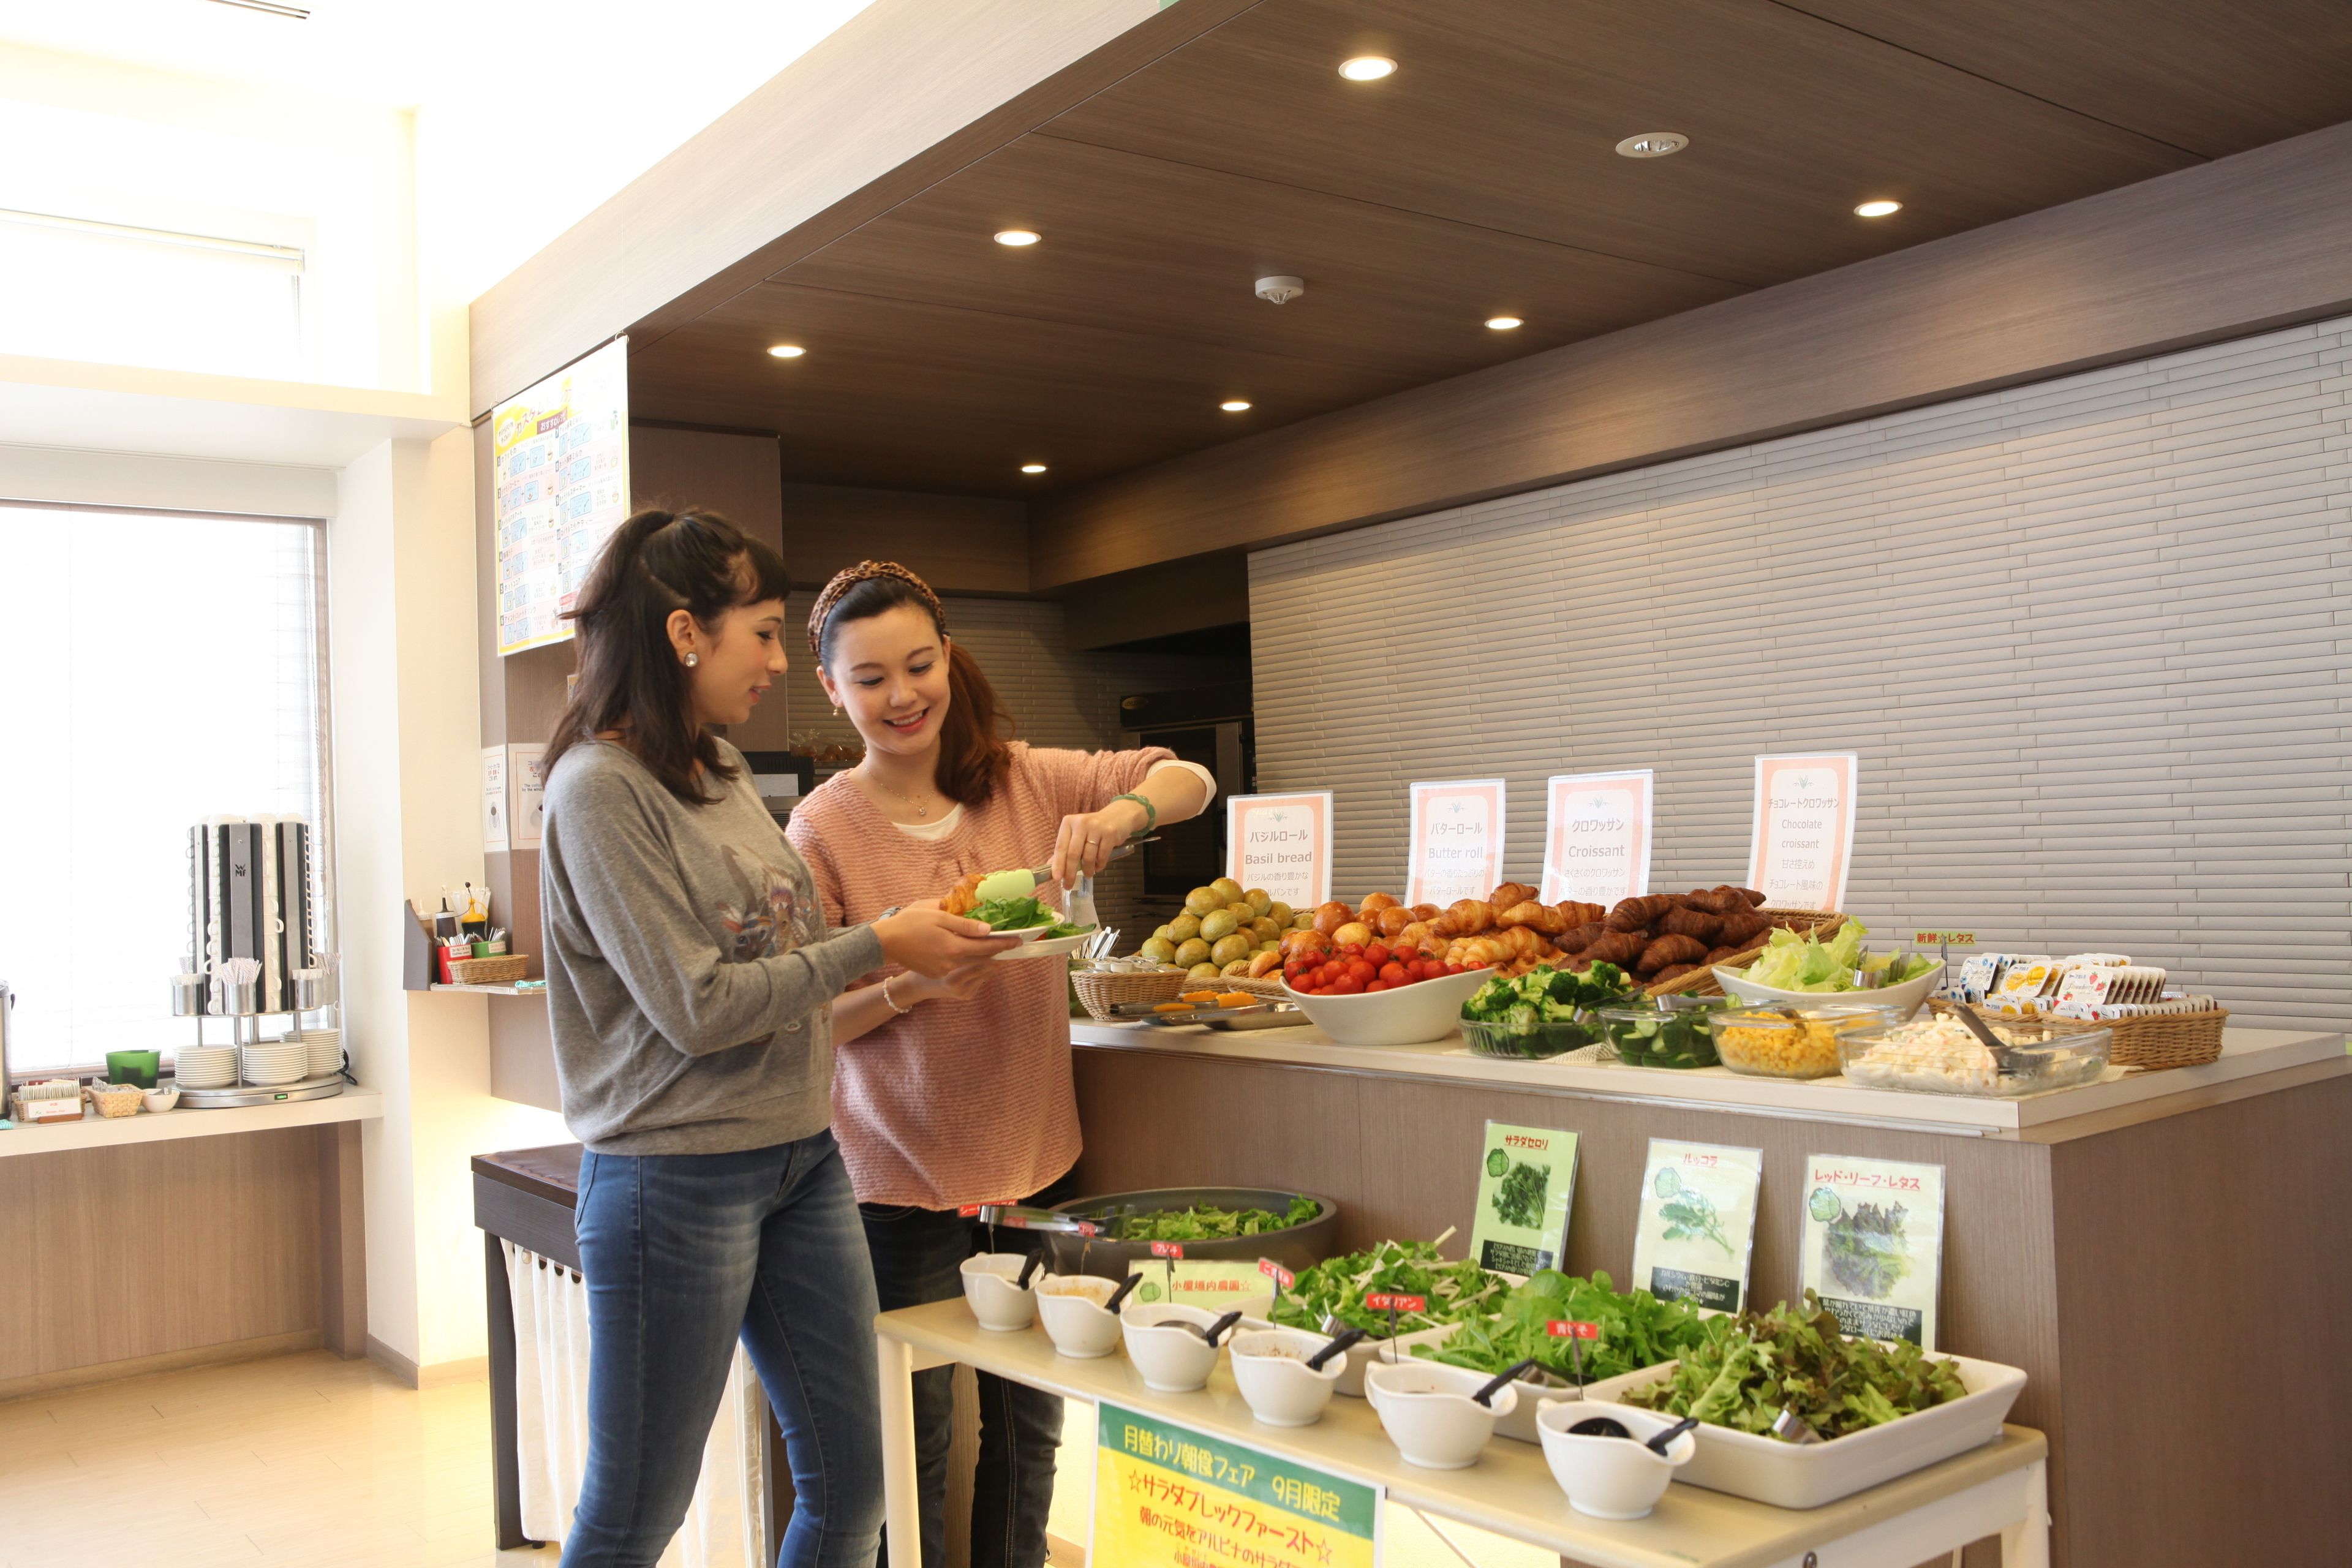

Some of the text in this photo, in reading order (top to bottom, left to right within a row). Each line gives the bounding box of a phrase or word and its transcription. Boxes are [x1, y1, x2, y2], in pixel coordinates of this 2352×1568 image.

[1768, 797, 1839, 809] チョコレートクロワッサン
[1431, 822, 1482, 835] バターロール
[1572, 818, 1624, 832] クロワッサン
[1782, 819, 1822, 829] Chocolate
[1250, 829, 1308, 843] バジルロール
[1782, 839, 1819, 848] croissant
[1245, 851, 1312, 864] Basil bread
[1429, 846, 1483, 858] Butter roll
[1569, 845, 1625, 858] Croissant
[1246, 872, 1309, 882] バジルの香り豊かな
[1564, 867, 1626, 878] さくさくのクロワッサン
[1769, 879, 1823, 891] チョコレート風味の
[1505, 1135, 1548, 1150] サラダセロリ
[1683, 1153, 1718, 1166] ルッコラ
[1124, 1424, 1341, 1523] 月替わり朝食フェア 9月限定
